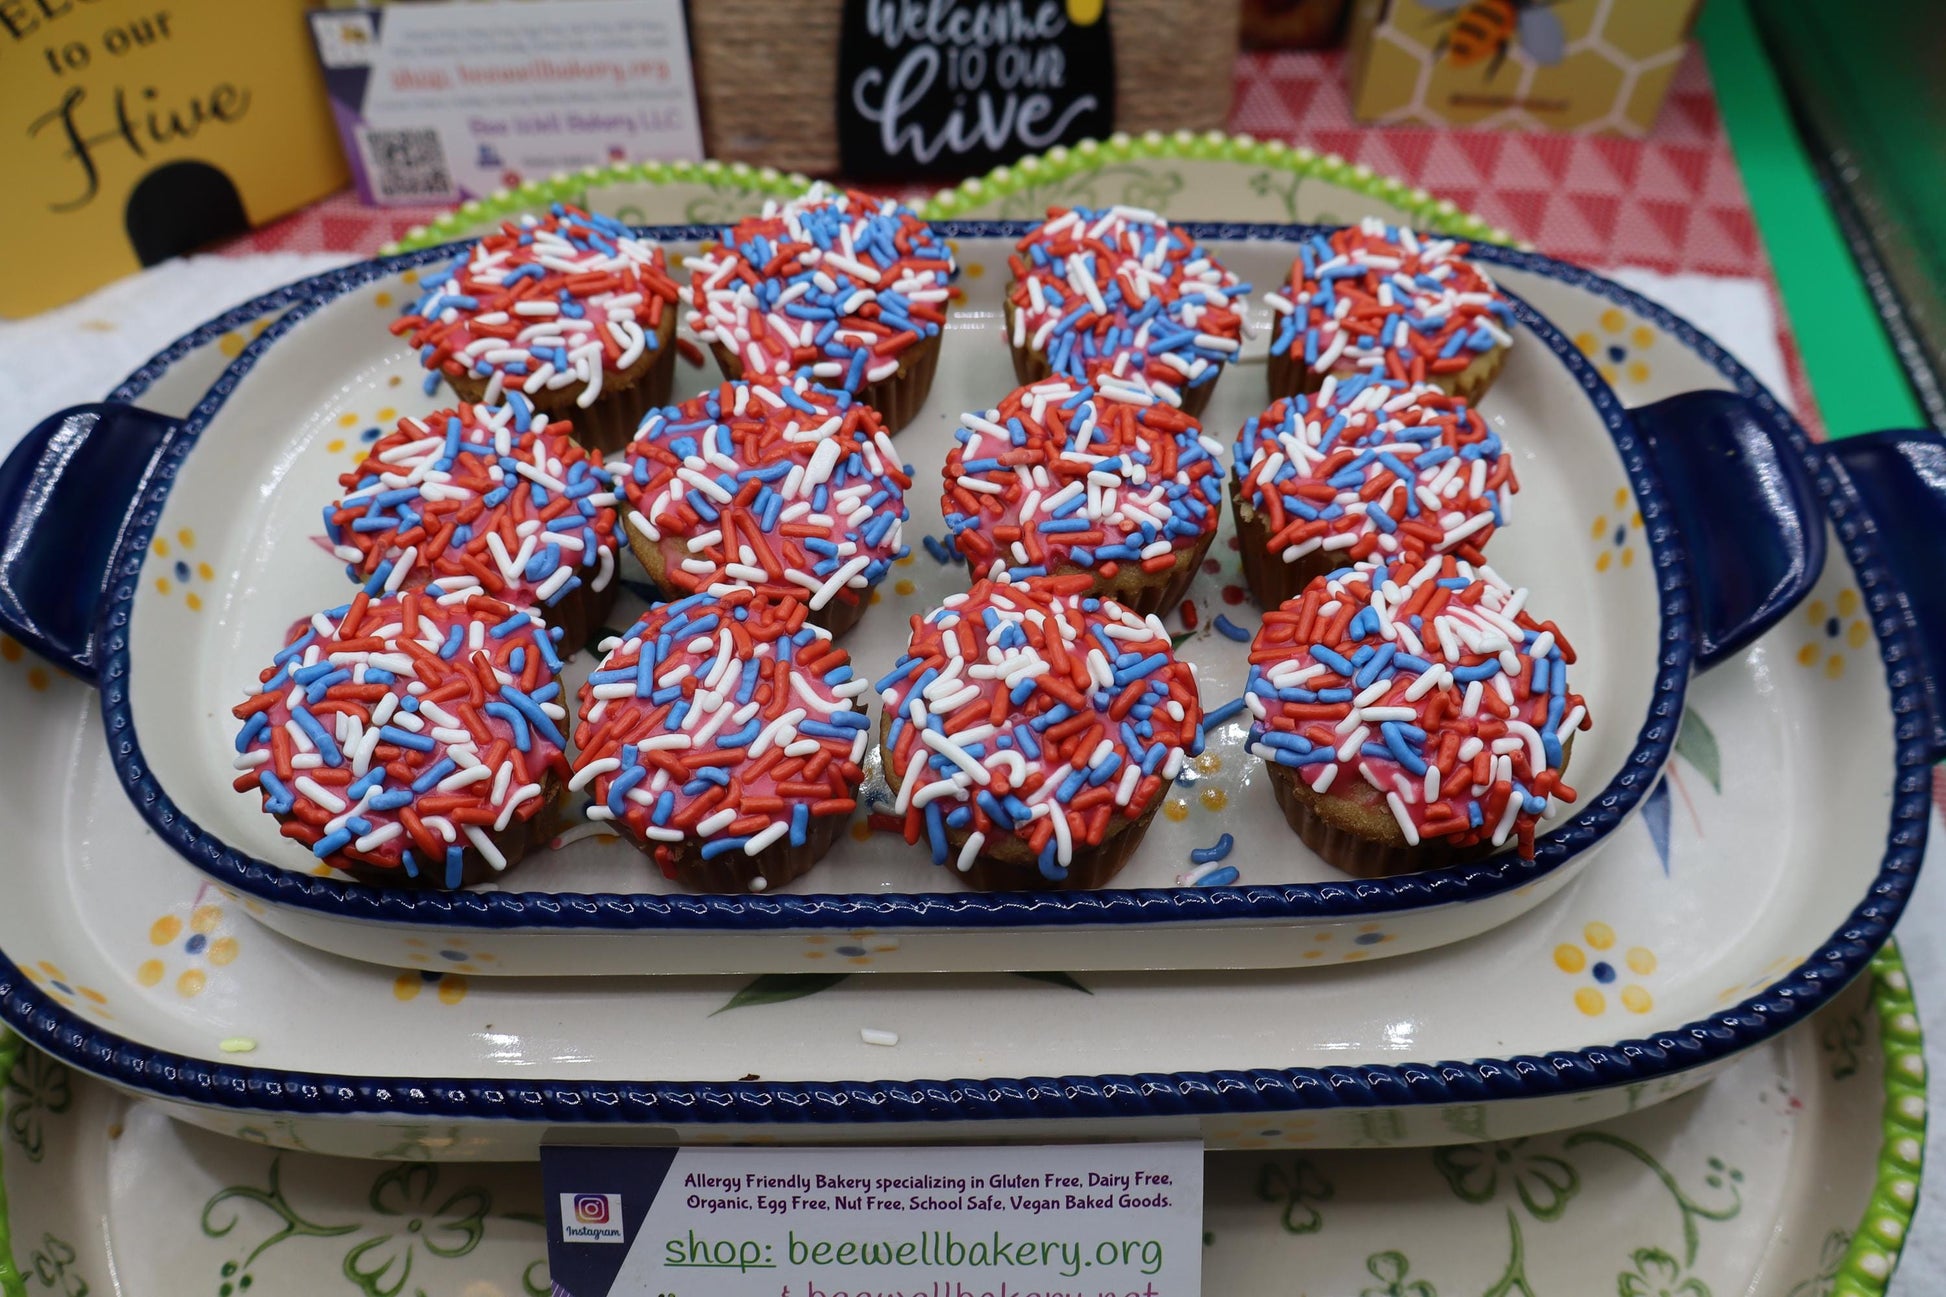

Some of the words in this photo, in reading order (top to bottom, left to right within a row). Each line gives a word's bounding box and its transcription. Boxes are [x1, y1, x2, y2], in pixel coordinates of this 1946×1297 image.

[44, 42, 91, 75] to
[103, 10, 171, 55] our
[853, 44, 1097, 165] hive
[26, 82, 252, 214] Hive
[684, 1172, 741, 1192] Allergy
[746, 1173, 811, 1192] Friendly
[815, 1174, 871, 1192] Bakery
[876, 1174, 966, 1193] specializing
[970, 1175, 985, 1189] in
[989, 1174, 1040, 1189] Gluten
[1045, 1173, 1084, 1189] Free,
[1088, 1172, 1130, 1191] Dairy
[1134, 1171, 1173, 1187] Free,
[687, 1195, 752, 1214] Organic,
[757, 1195, 787, 1214] Egg
[792, 1196, 830, 1212] Free,
[835, 1196, 863, 1211] Nut
[867, 1197, 905, 1212] Free,
[909, 1196, 963, 1210] School
[967, 1196, 1006, 1212] Safe,
[1009, 1196, 1061, 1214] Vegan
[1065, 1195, 1114, 1209] Baked
[1118, 1194, 1173, 1209] Goods.
[566, 1225, 621, 1241] Instagram
[664, 1229, 776, 1273] shop:
[789, 1230, 1163, 1277] beewellbakery.org
